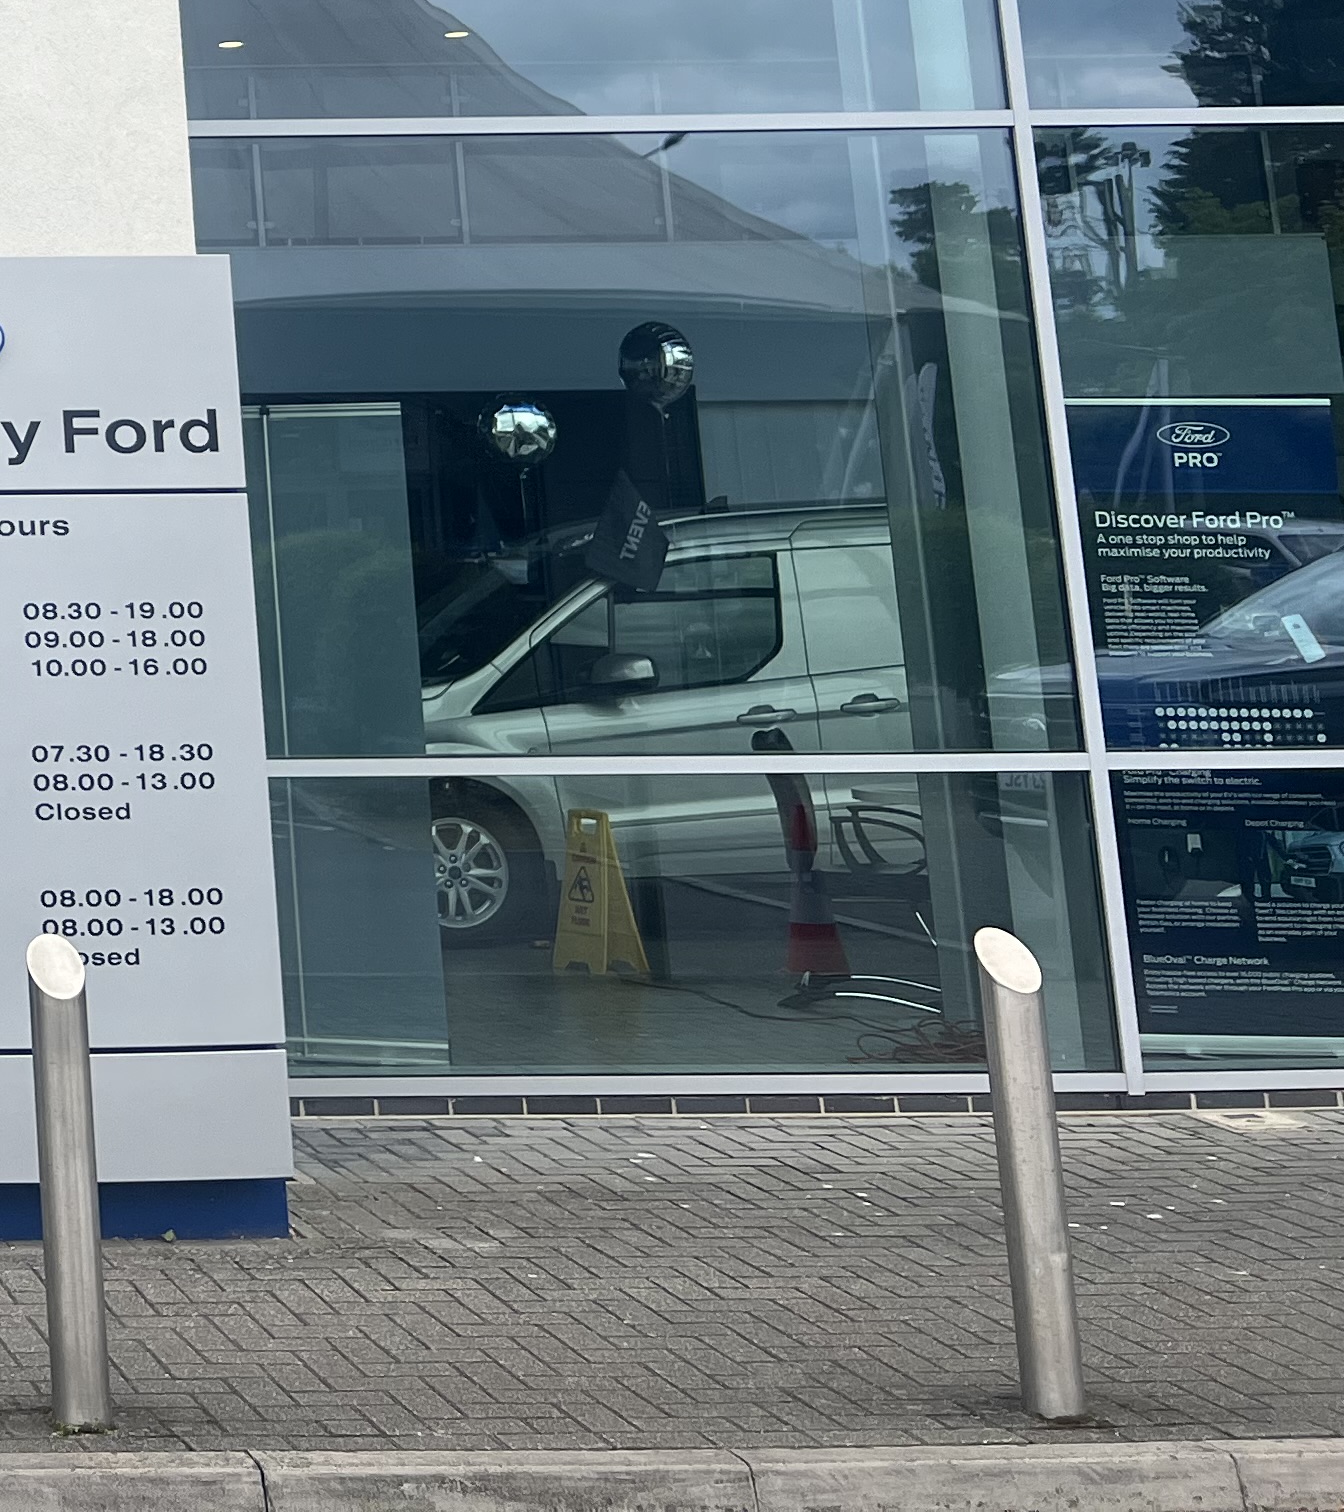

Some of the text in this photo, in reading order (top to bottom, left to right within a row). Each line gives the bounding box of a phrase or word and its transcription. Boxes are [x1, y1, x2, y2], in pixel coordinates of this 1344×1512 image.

[63, 408, 220, 454] Ford
[1171, 425, 1216, 443] Ford
[1094, 511, 1186, 528] Discover
[1192, 511, 1241, 528] Ford
[1096, 534, 1247, 546] A one stop shop to help
[1097, 547, 1271, 559] maximise your productivity
[1100, 575, 1122, 583] Ford
[1146, 574, 1190, 583] Software
[23, 602, 102, 621] 08.30
[124, 601, 204, 620] 19.00
[24, 630, 105, 649] 09.00
[126, 629, 206, 648] 18.00
[31, 658, 107, 677] 10.00
[128, 657, 208, 676] 16.00
[31, 744, 110, 763] 07.30
[134, 743, 213, 762] 18.30
[33, 773, 114, 792] 08.00
[135, 771, 215, 791] 13.00
[1123, 775, 1162, 785] Simplify
[1164, 775, 1180, 784] the
[1214, 777, 1224, 785] to
[35, 802, 131, 821] Closed
[40, 889, 122, 908] 08.00
[143, 887, 223, 907] 18.00
[42, 918, 123, 937] 08.00
[145, 916, 226, 936] 13.00
[79, 947, 140, 967] osed
[1194, 956, 1228, 966] Charge
[1229, 957, 1270, 966] Network
